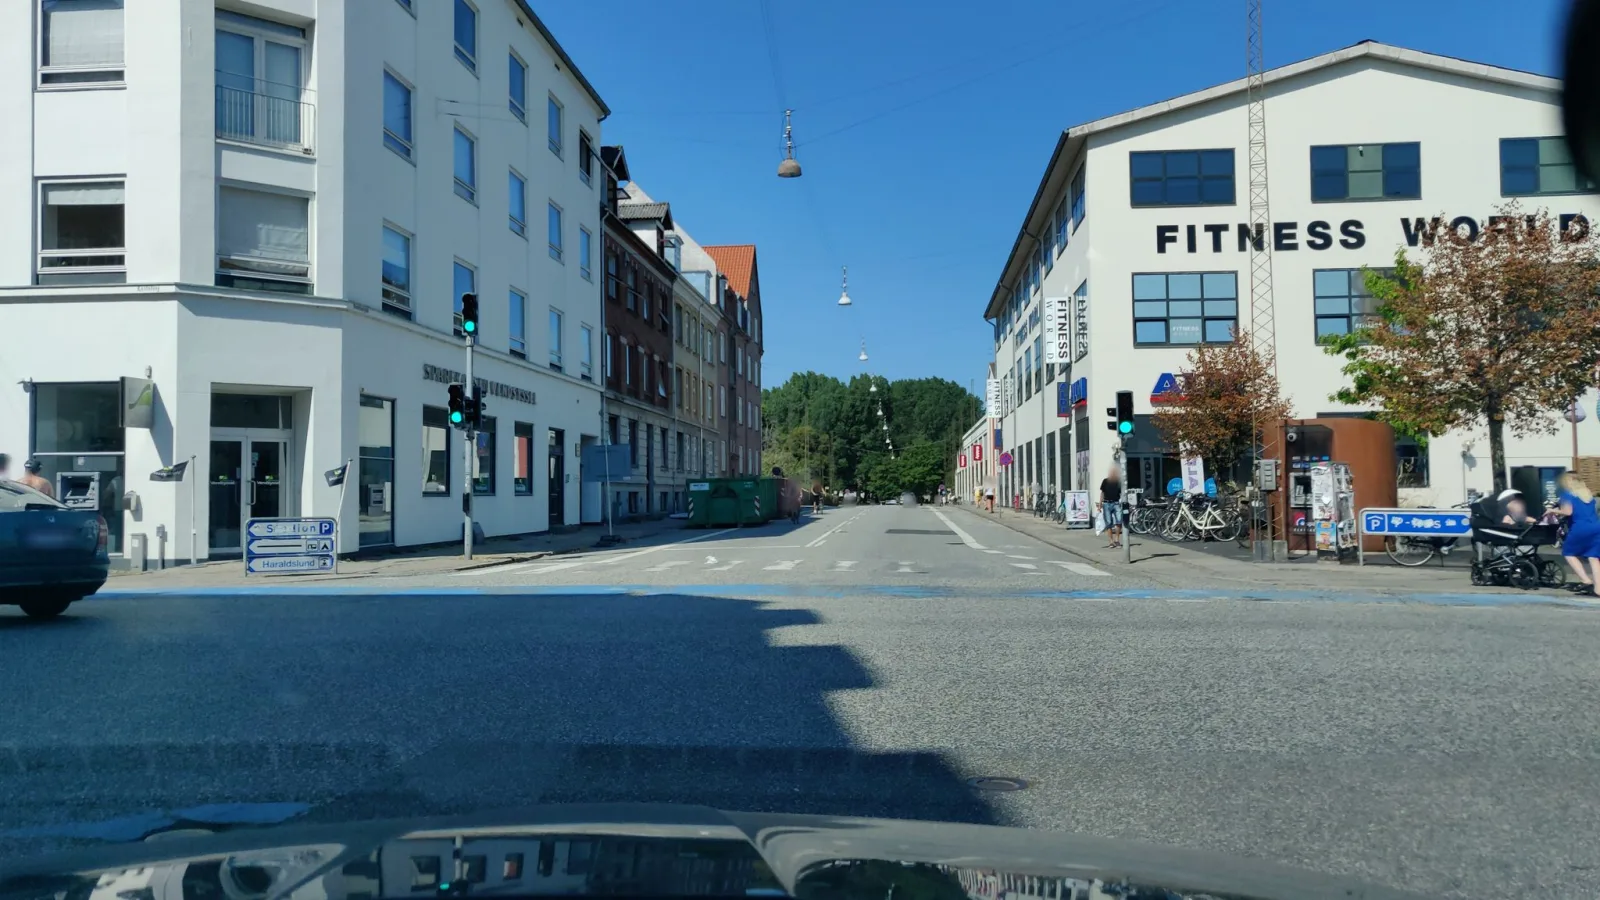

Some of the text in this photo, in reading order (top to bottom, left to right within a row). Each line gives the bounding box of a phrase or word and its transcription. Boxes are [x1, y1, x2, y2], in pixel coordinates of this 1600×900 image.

[1156, 219, 1366, 254] FITNESS
[1045, 300, 1055, 360] WORLD
[1057, 300, 1068, 359] FITNESS
[422, 363, 489, 393] SPAREKASEN
[262, 559, 315, 568] Haraldslund
